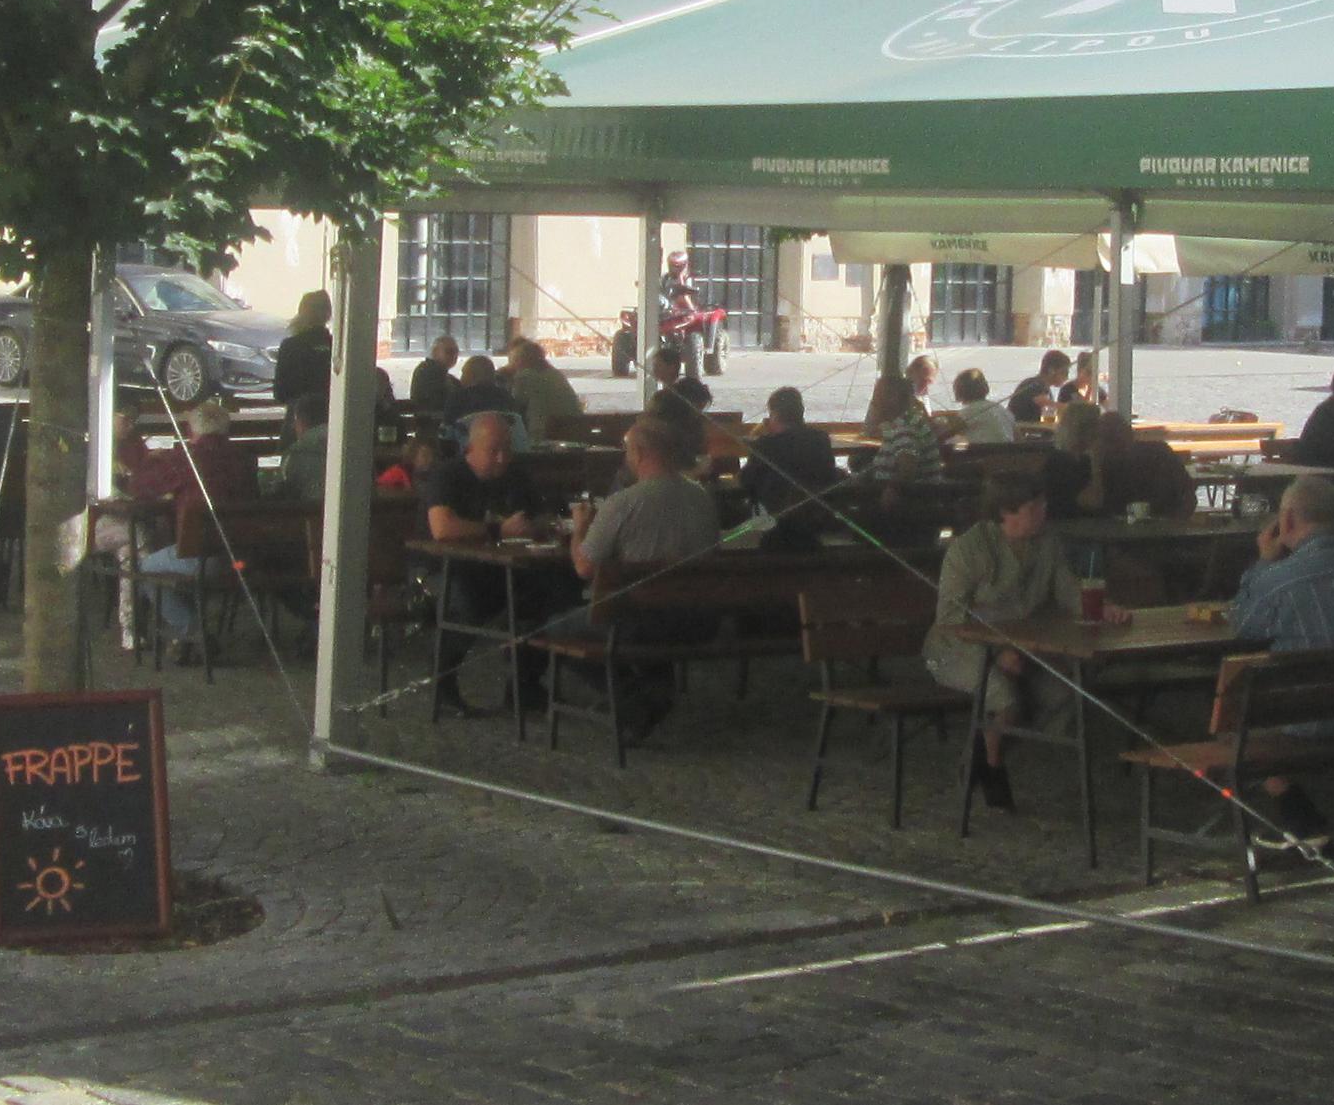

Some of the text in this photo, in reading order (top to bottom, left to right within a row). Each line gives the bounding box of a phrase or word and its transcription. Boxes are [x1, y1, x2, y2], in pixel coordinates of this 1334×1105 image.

[817, 158, 891, 175] KAMENICE
[1139, 156, 1310, 175] PIVOVAR KAMENICE
